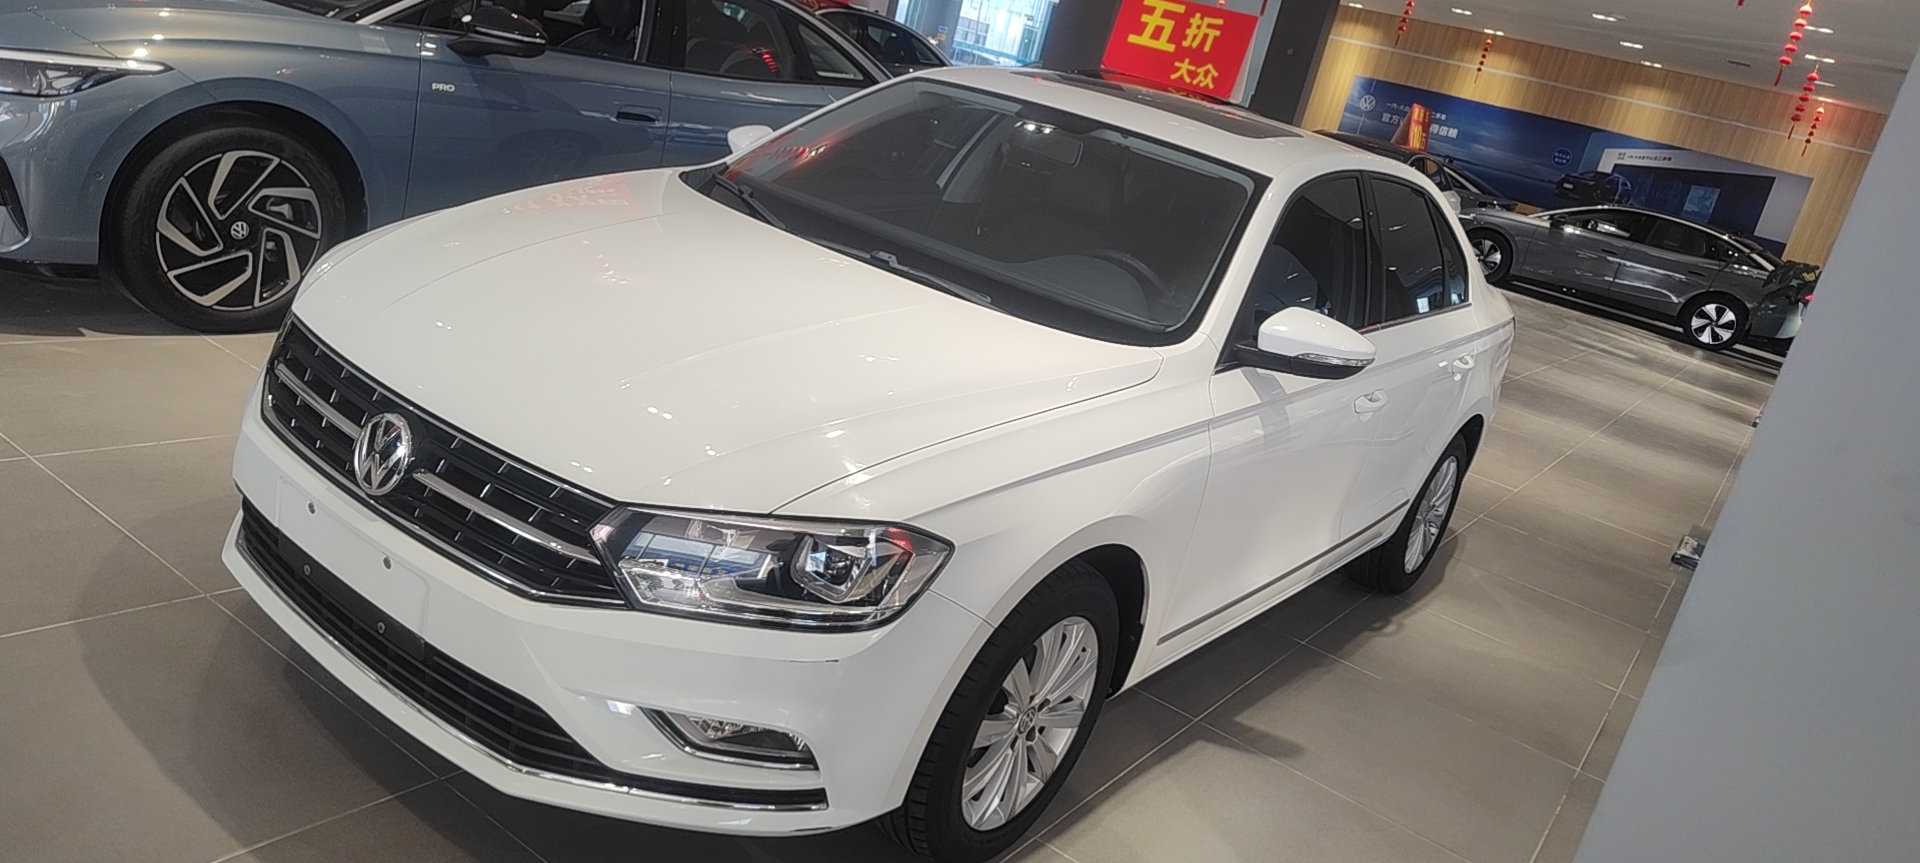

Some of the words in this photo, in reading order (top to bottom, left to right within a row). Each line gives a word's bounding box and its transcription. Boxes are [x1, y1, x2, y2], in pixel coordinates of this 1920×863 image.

[1127, 0, 1224, 53] 五折
[431, 82, 456, 93] PRO
[1170, 58, 1219, 90] 大众
